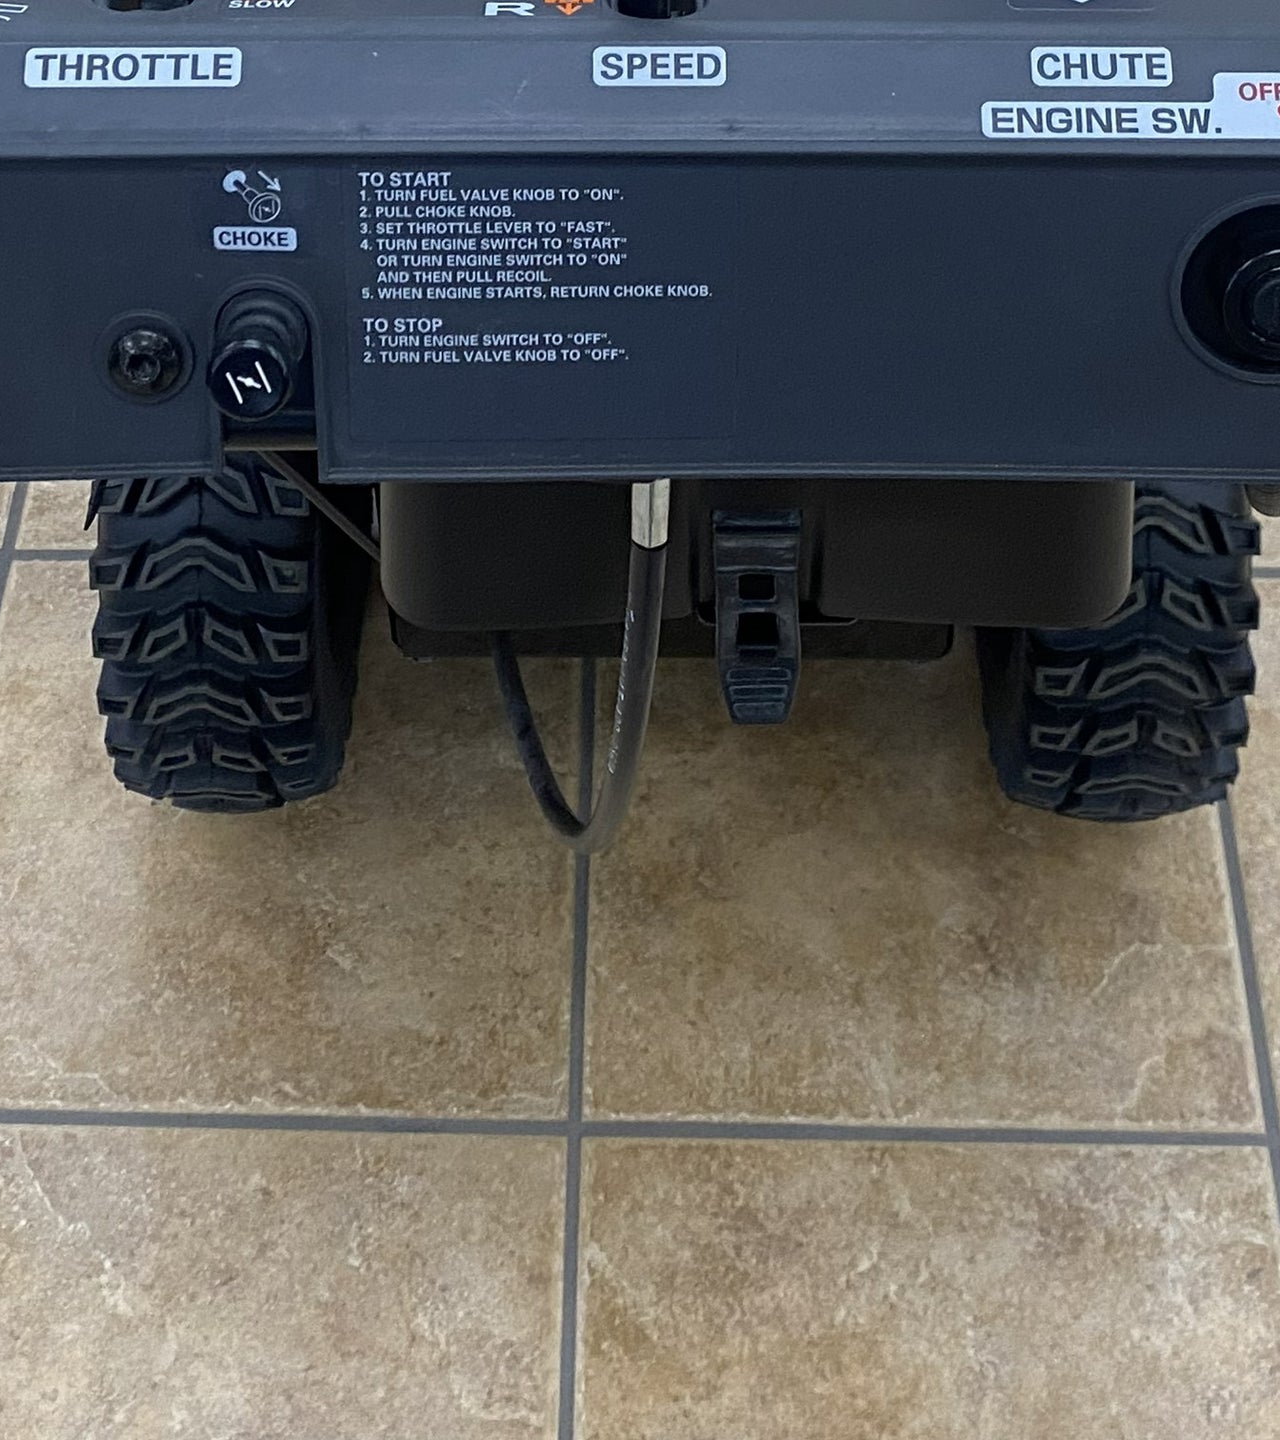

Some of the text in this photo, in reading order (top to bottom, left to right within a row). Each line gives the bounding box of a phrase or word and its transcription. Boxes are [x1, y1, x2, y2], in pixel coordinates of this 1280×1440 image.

[228, 0, 295, 9] SLOW
[484, 2, 536, 16] R
[34, 54, 233, 81] THROTTLE
[600, 54, 721, 80] SPEED
[1037, 53, 1168, 80] CHUTE
[991, 106, 1221, 134] ENGINE SW.
[358, 172, 451, 186] TO START
[360, 189, 623, 201] 1. TURN FUEL VALVE KNOB TO "ON".
[360, 206, 515, 218] 2. PULL CHOKE KNOB.
[360, 221, 614, 234] 3. SET THROTTLE LEVER TO "FAST".
[219, 231, 289, 247] CHOKE
[360, 238, 626, 250] 4. TURN ENGINE SWITCH TO "START"
[377, 254, 626, 266] OR TURN ENGINE SWITCH TO "ON"
[377, 271, 551, 283] AND THEN PULL RECOIL.
[362, 285, 712, 299] 5. WHEN ENGINE STARTS, RETURN CHOKE KNOB.
[363, 318, 442, 332] TO STOP
[365, 333, 611, 347] 1. TURN ENGINE SWITCH TO "OFF".
[364, 349, 628, 363] 2. TURN FUEL VALVE KNOB TO "OFF".
